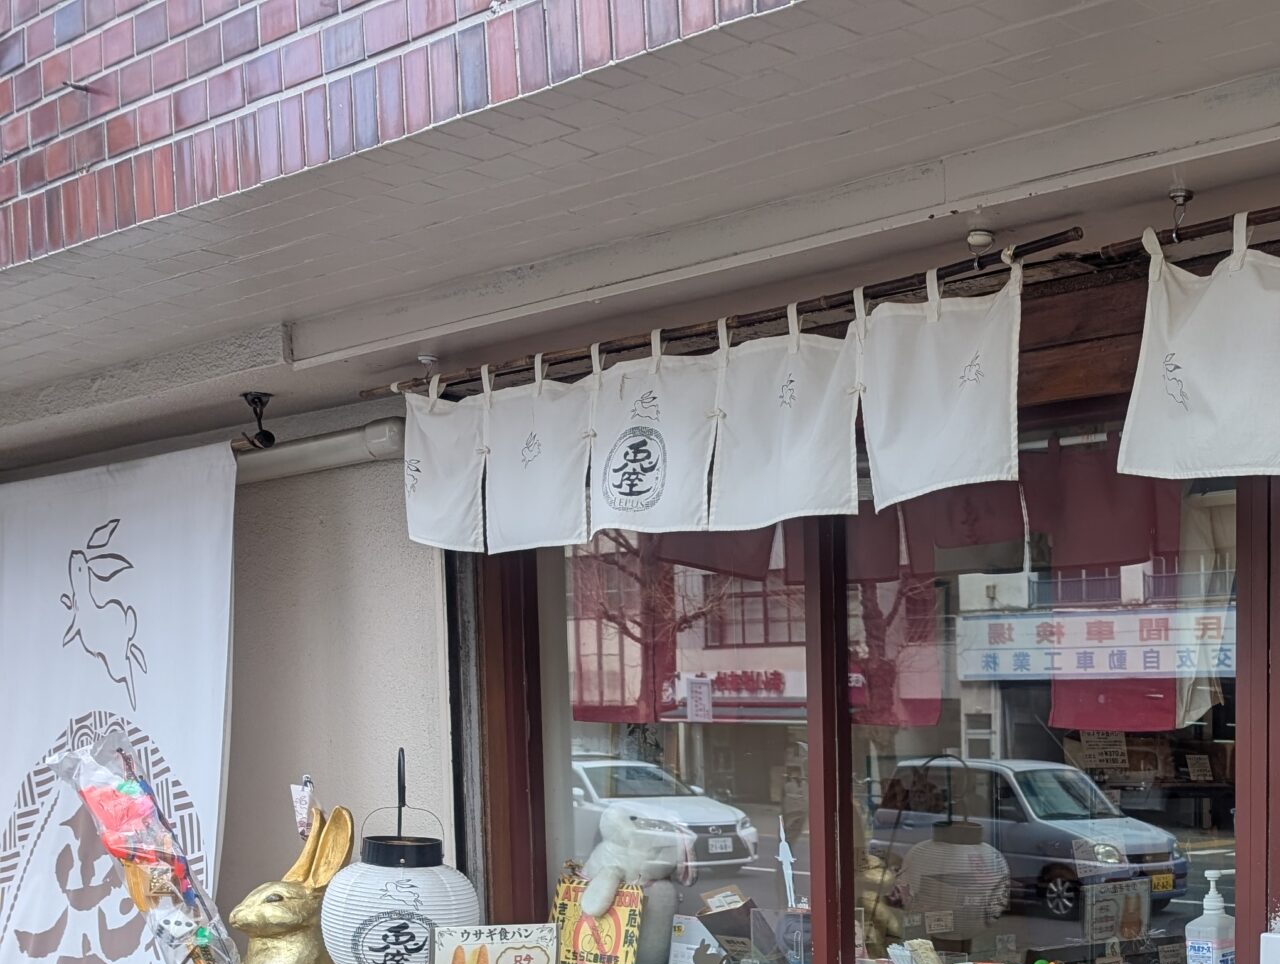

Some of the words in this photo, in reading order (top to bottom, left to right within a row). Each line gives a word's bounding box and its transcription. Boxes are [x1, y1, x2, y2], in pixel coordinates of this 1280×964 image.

[460, 928, 535, 942] ウサギ食パン
